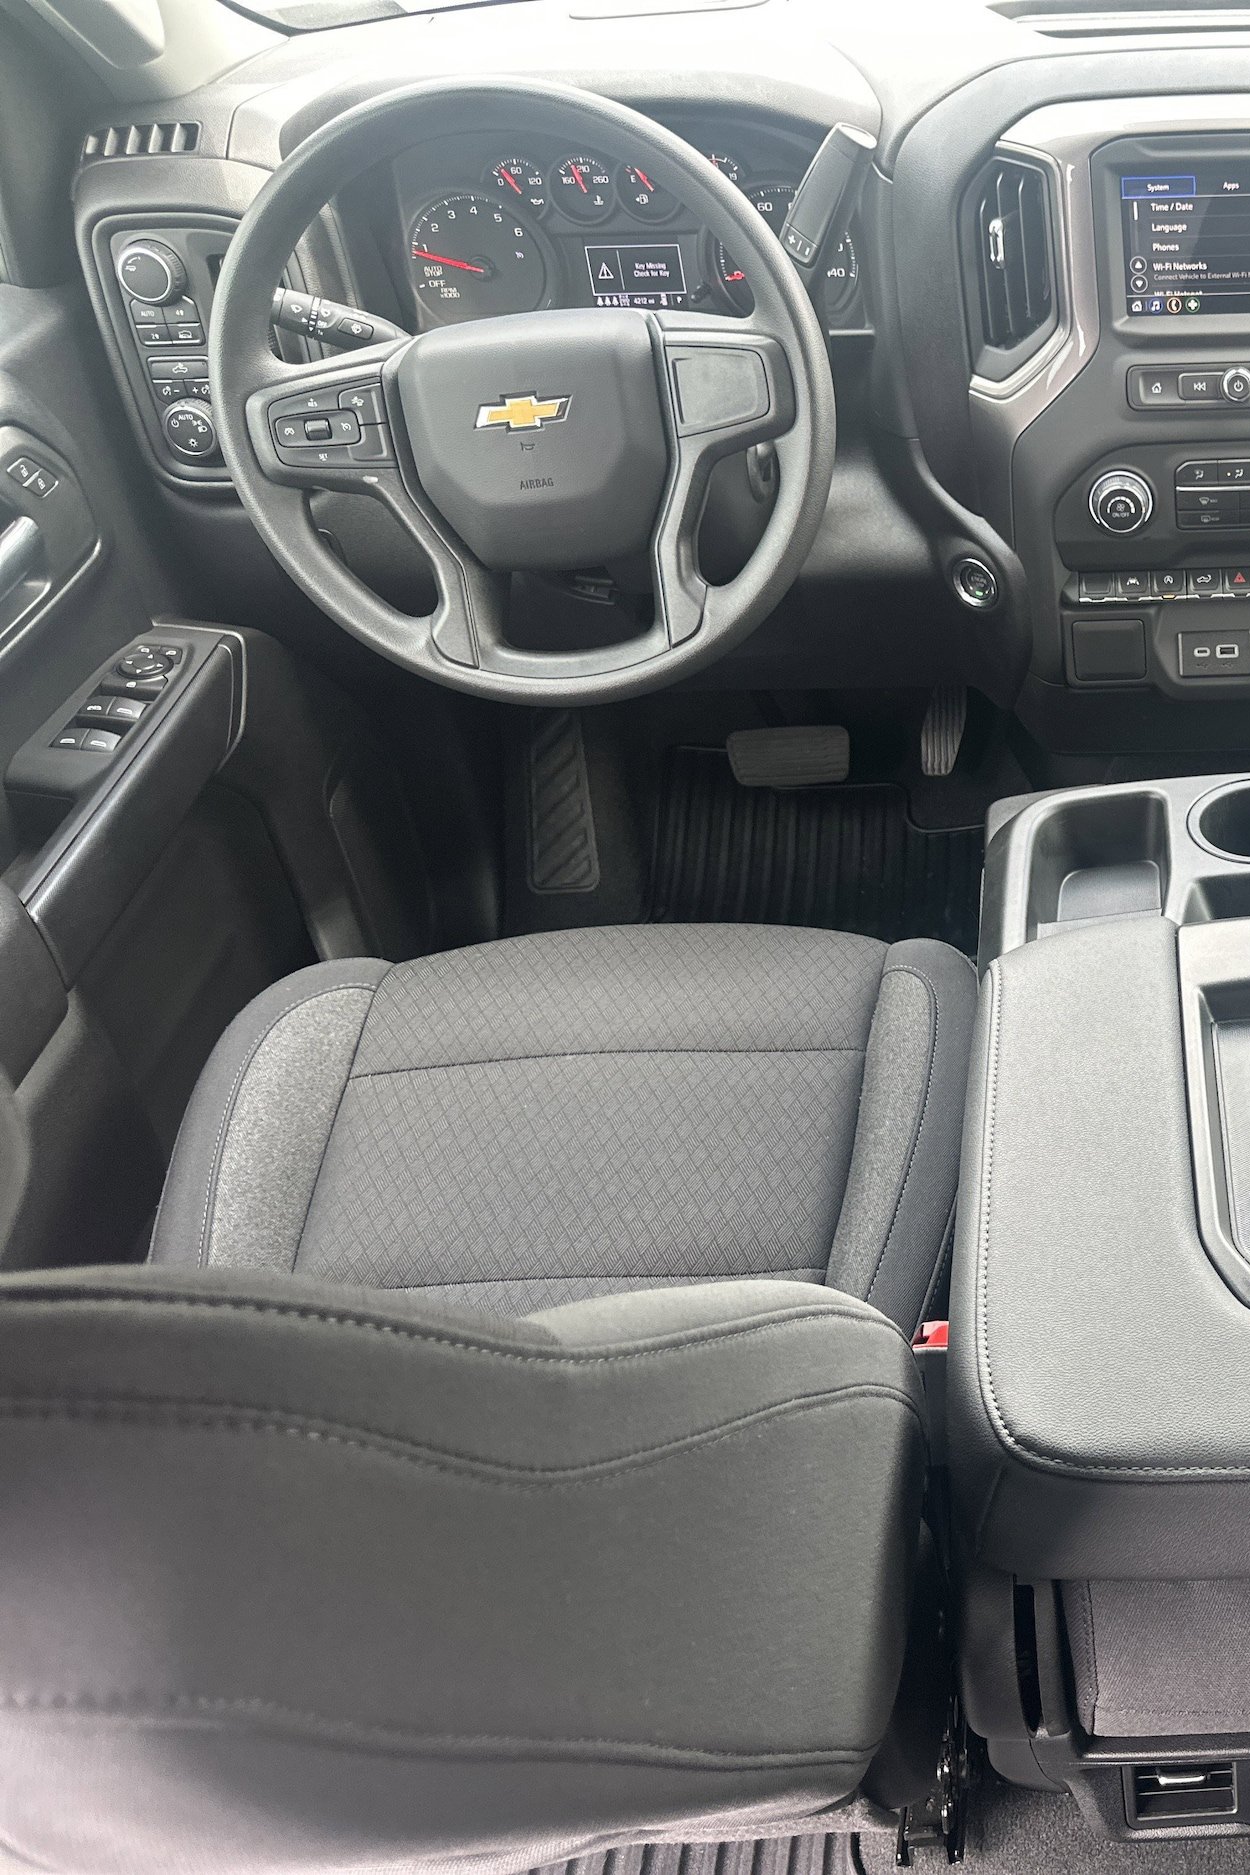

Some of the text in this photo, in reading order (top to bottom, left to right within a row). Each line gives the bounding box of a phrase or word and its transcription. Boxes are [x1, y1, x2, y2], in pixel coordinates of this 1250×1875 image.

[630, 175, 636, 183] E
[1146, 184, 1170, 192] System
[1222, 182, 1240, 190] Apps
[470, 206, 478, 214] 4
[758, 202, 772, 212] 60
[1150, 202, 1169, 212] Time
[1175, 202, 1194, 211] Date
[448, 210, 456, 220] 3
[494, 213, 502, 222] 5
[430, 223, 439, 232] 2
[1152, 223, 1188, 233] Language
[514, 228, 523, 237] 6
[422, 244, 428, 252] 1
[1152, 243, 1180, 252] Phones
[646, 262, 666, 270] Missing
[1152, 262, 1208, 270] Wi-Fi Networks
[634, 270, 650, 278] Check
[659, 270, 670, 278] Key
[520, 478, 554, 490] AIRBAG
